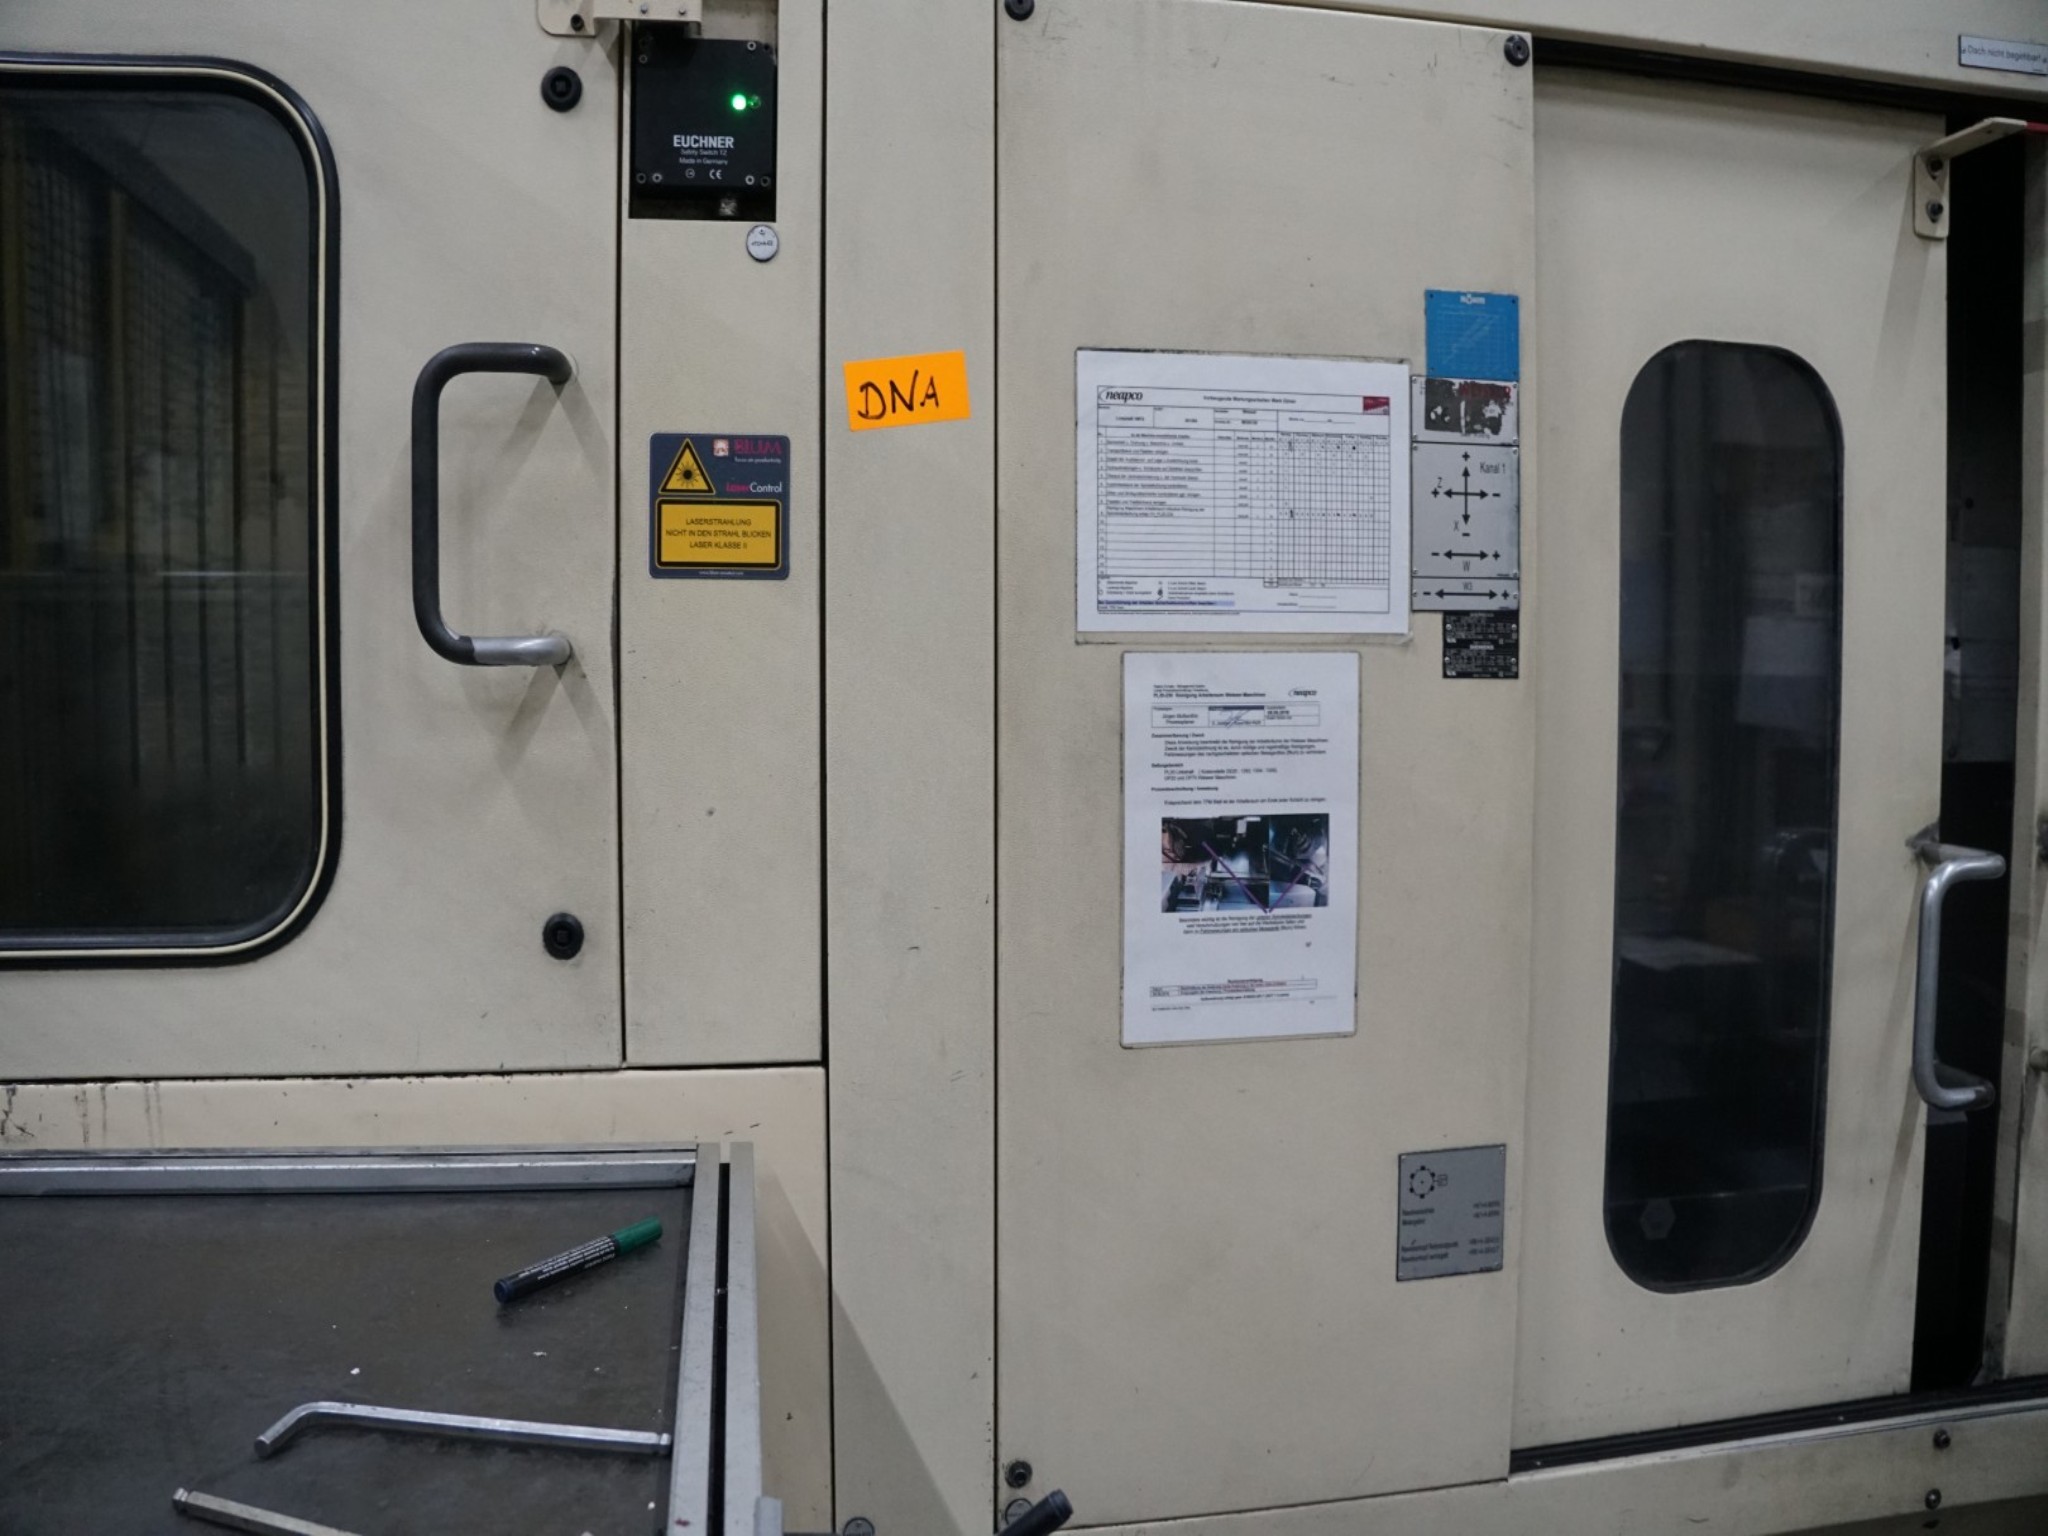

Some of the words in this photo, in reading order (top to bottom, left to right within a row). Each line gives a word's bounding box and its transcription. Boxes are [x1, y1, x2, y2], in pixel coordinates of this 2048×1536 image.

[673, 135, 734, 148] EUCHNER
[702, 158, 728, 166] Germany
[857, 369, 939, 420] DNA
[1105, 391, 1143, 403] neapco
[735, 439, 782, 454] BLUM
[1479, 461, 1500, 474] Kanal
[686, 518, 752, 526] LASERSTRAHLUNG
[1453, 521, 1460, 532] X
[666, 529, 687, 537] NICHT
[713, 530, 740, 538] STRAHL
[742, 530, 772, 538] BLICKEN
[689, 541, 713, 549] LASER
[1462, 560, 1471, 572] W
